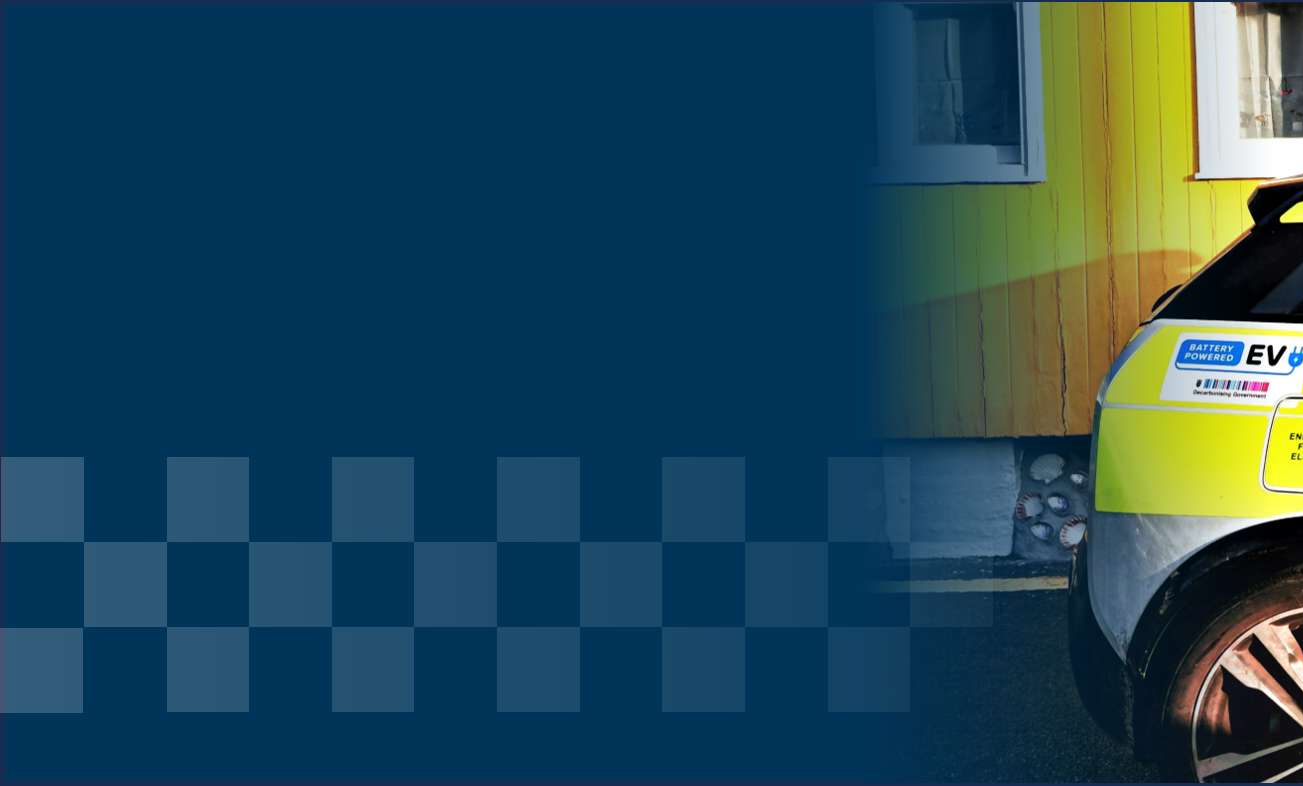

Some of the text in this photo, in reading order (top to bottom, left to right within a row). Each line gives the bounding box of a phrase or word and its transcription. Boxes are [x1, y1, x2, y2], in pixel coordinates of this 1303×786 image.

[1189, 344, 1234, 353] BATTERY
[1184, 352, 1233, 361] POWERED
[1246, 344, 1287, 366] EV
[1193, 389, 1231, 397] Decarbonising
